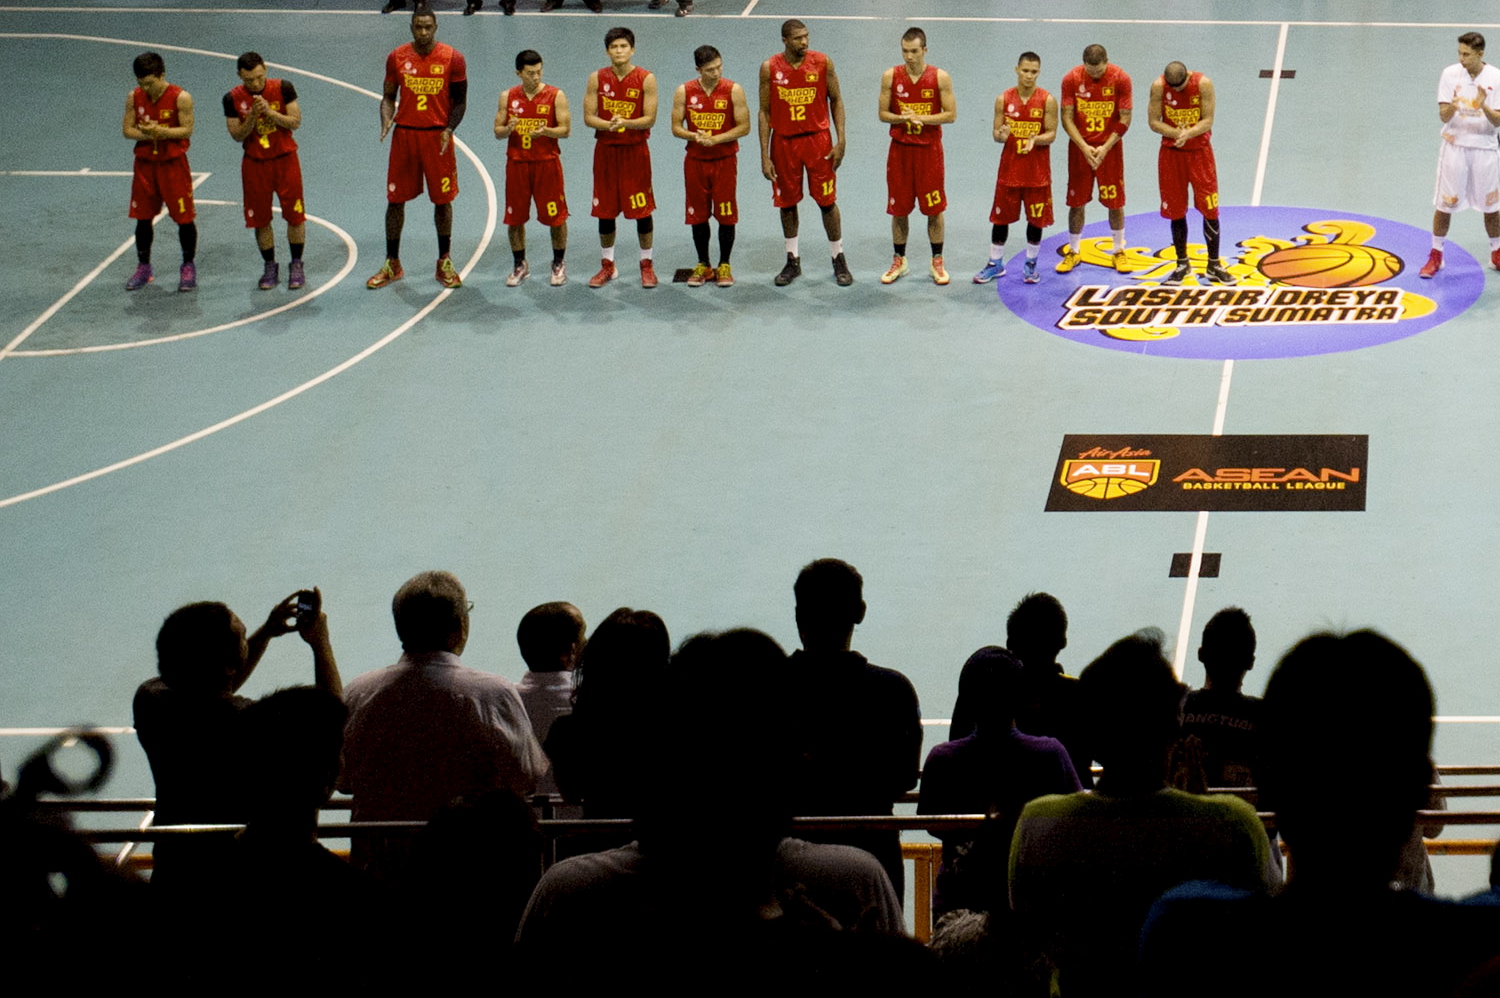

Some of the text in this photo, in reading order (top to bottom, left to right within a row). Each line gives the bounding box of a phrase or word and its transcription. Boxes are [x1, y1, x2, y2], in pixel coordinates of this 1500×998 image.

[406, 77, 445, 87] SAIGON
[780, 87, 817, 97] SAIGON
[416, 95, 428, 111] 2
[1079, 101, 1116, 110] SAIGON
[691, 113, 725, 122] SAIGON
[789, 105, 807, 121] 12
[1167, 108, 1201, 117] SAIGON
[1086, 117, 1105, 132] 33
[521, 135, 532, 149] 8
[441, 177, 451, 193] 2
[822, 179, 835, 196] 12
[1099, 184, 1117, 200] 33
[177, 197, 187, 214] 1
[293, 198, 304, 214] 4
[629, 191, 647, 210] 10
[925, 190, 942, 207] 13
[1204, 192, 1219, 210] 18
[547, 201, 558, 217] 8
[719, 201, 733, 217] 11
[1029, 202, 1045, 218] 17
[1079, 287, 1400, 307] LASKAR DREYA
[1069, 306, 1399, 327] SOUTH SUMATRA
[1071, 463, 1150, 477] ABL
[1172, 467, 1361, 483] ASEAN
[1182, 482, 1346, 490] BASKETBALL LEAGUE
